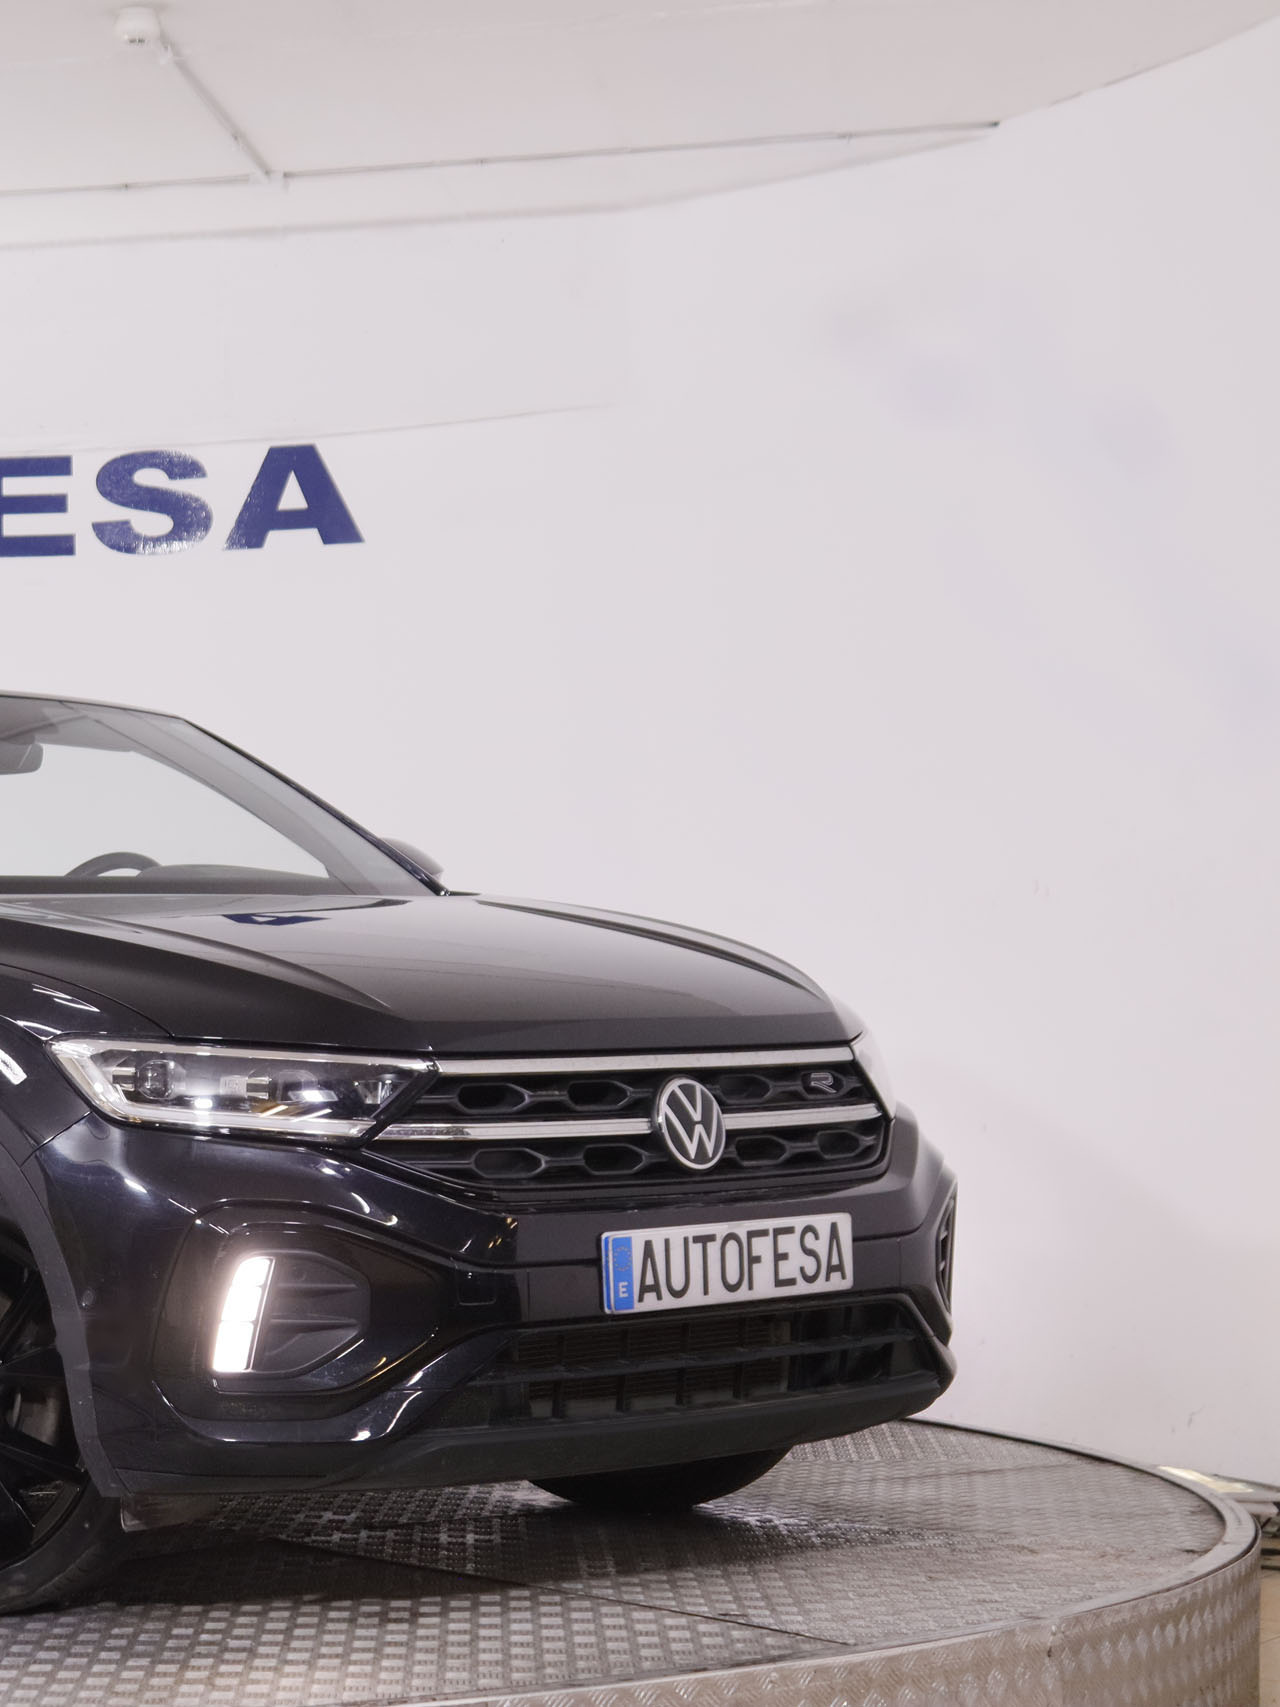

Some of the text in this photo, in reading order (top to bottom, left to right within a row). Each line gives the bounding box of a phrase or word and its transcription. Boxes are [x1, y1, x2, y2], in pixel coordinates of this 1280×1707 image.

[809, 1071, 837, 1094] R
[657, 1077, 726, 1170] VW
[637, 1221, 847, 1304] AUTOFESA
[619, 1281, 629, 1298] E
